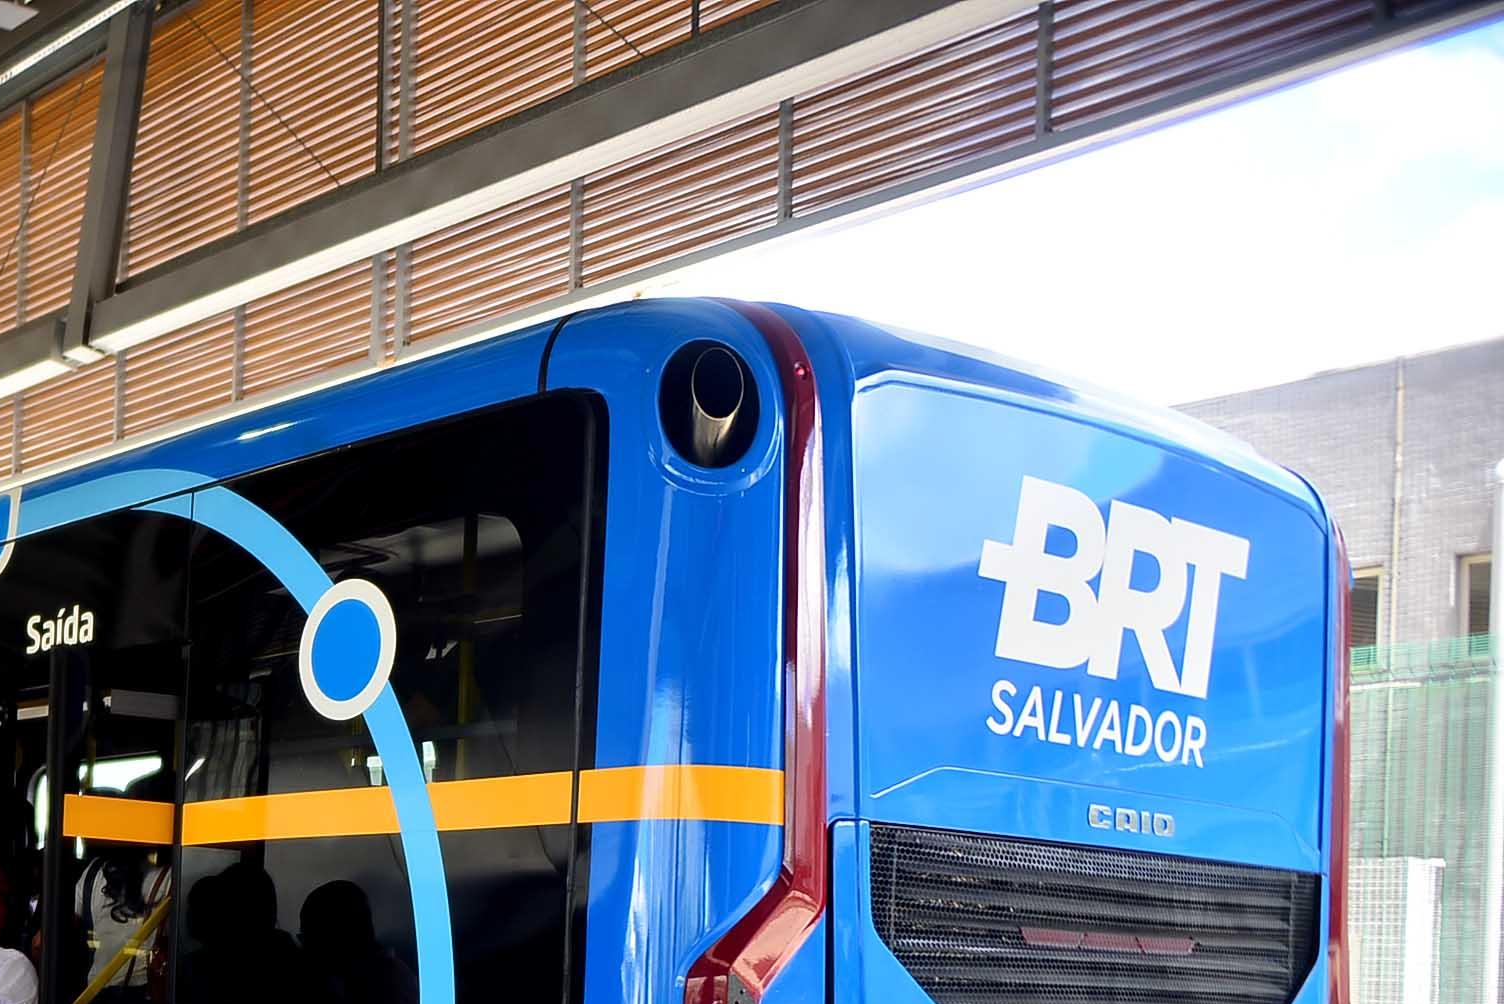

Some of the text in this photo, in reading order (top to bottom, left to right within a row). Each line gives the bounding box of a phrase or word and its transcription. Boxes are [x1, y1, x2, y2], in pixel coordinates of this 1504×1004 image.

[26, 604, 94, 655] Saída
[977, 474, 1251, 701] BRT
[985, 679, 1208, 769] SALVADOR
